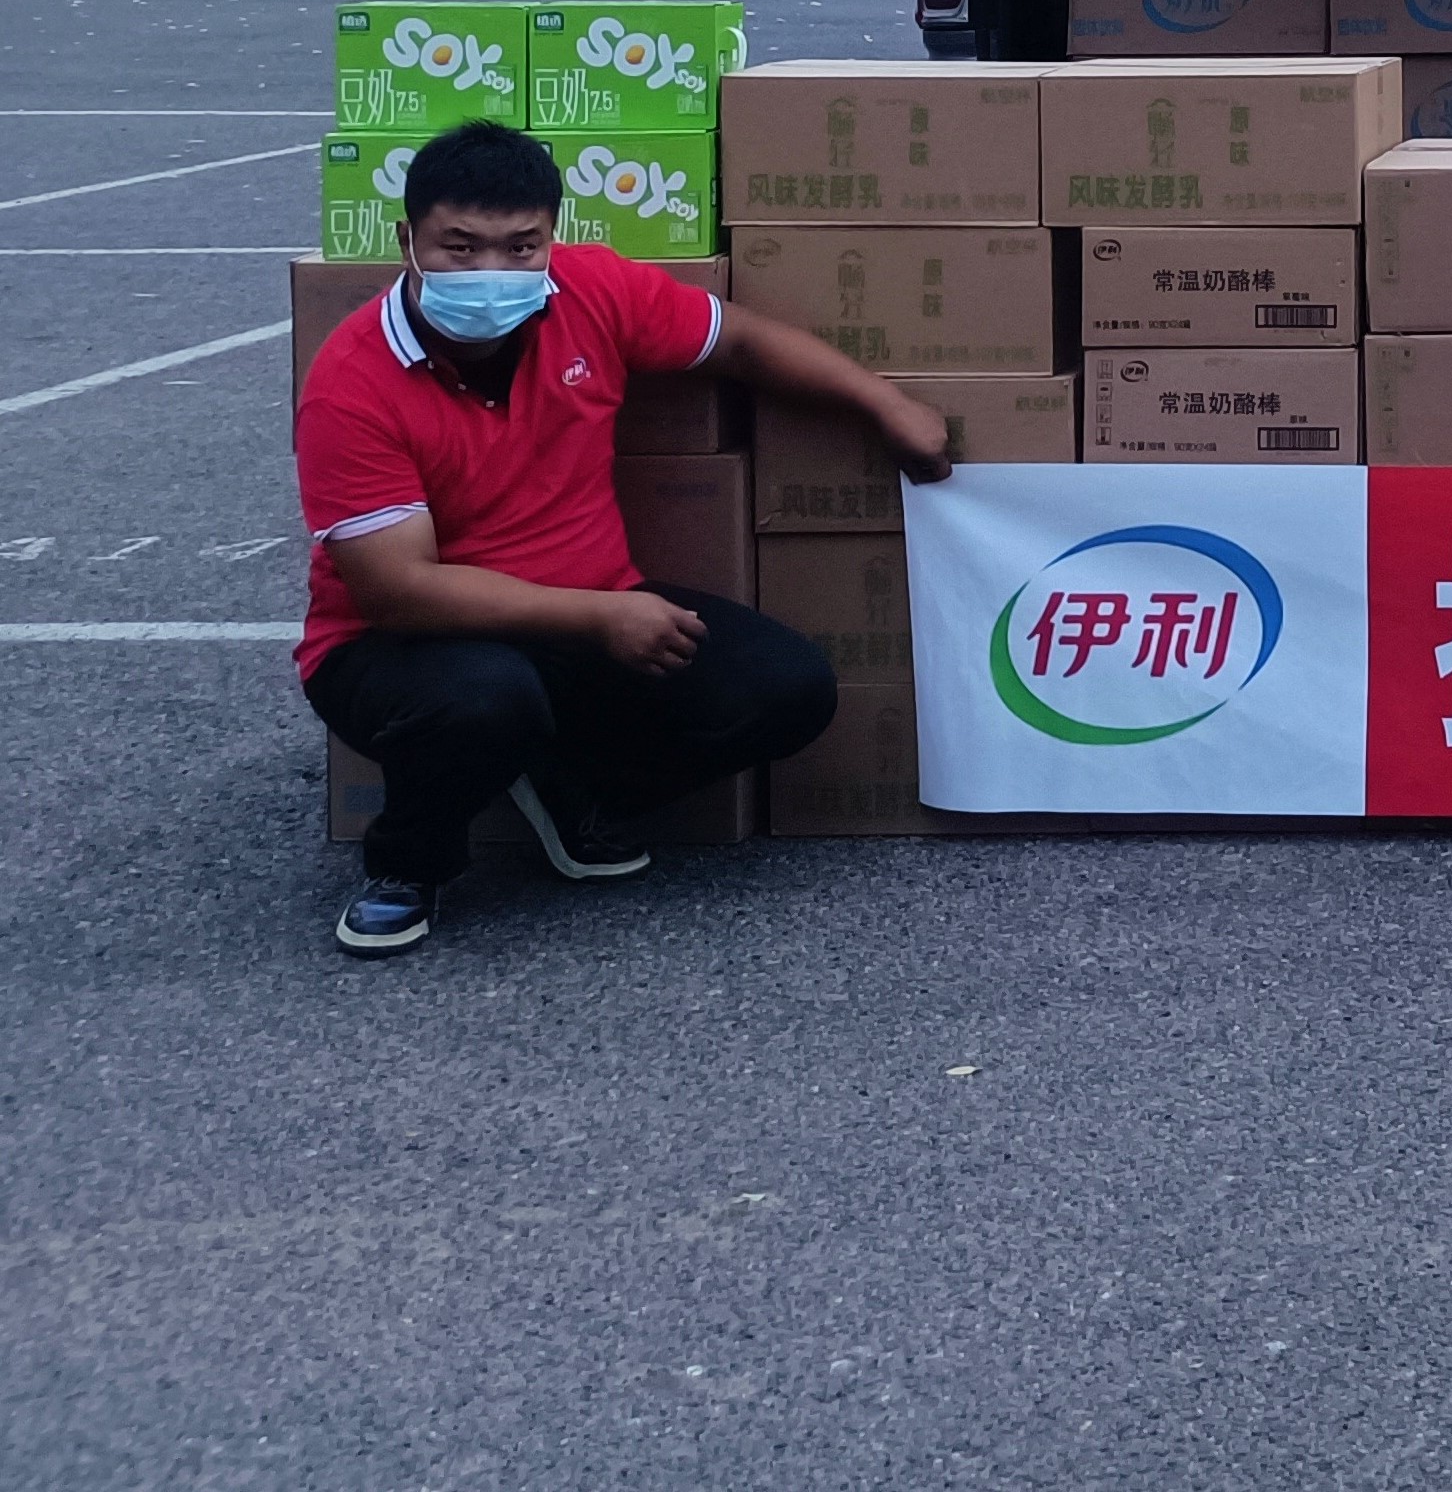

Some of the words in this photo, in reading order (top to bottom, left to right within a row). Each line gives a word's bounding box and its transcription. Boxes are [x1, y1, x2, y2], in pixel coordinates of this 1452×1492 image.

[338, 68, 395, 126] 豆奶
[534, 68, 589, 126] 豆奶
[747, 173, 883, 209] 风味发酵乳
[1068, 174, 1203, 209] 风味发酵乳
[328, 199, 385, 257] 豆奶
[1153, 268, 1276, 293] 常温奶酪棒
[1159, 391, 1282, 416] 常温奶酪棒
[1025, 591, 1239, 679] 伊利
